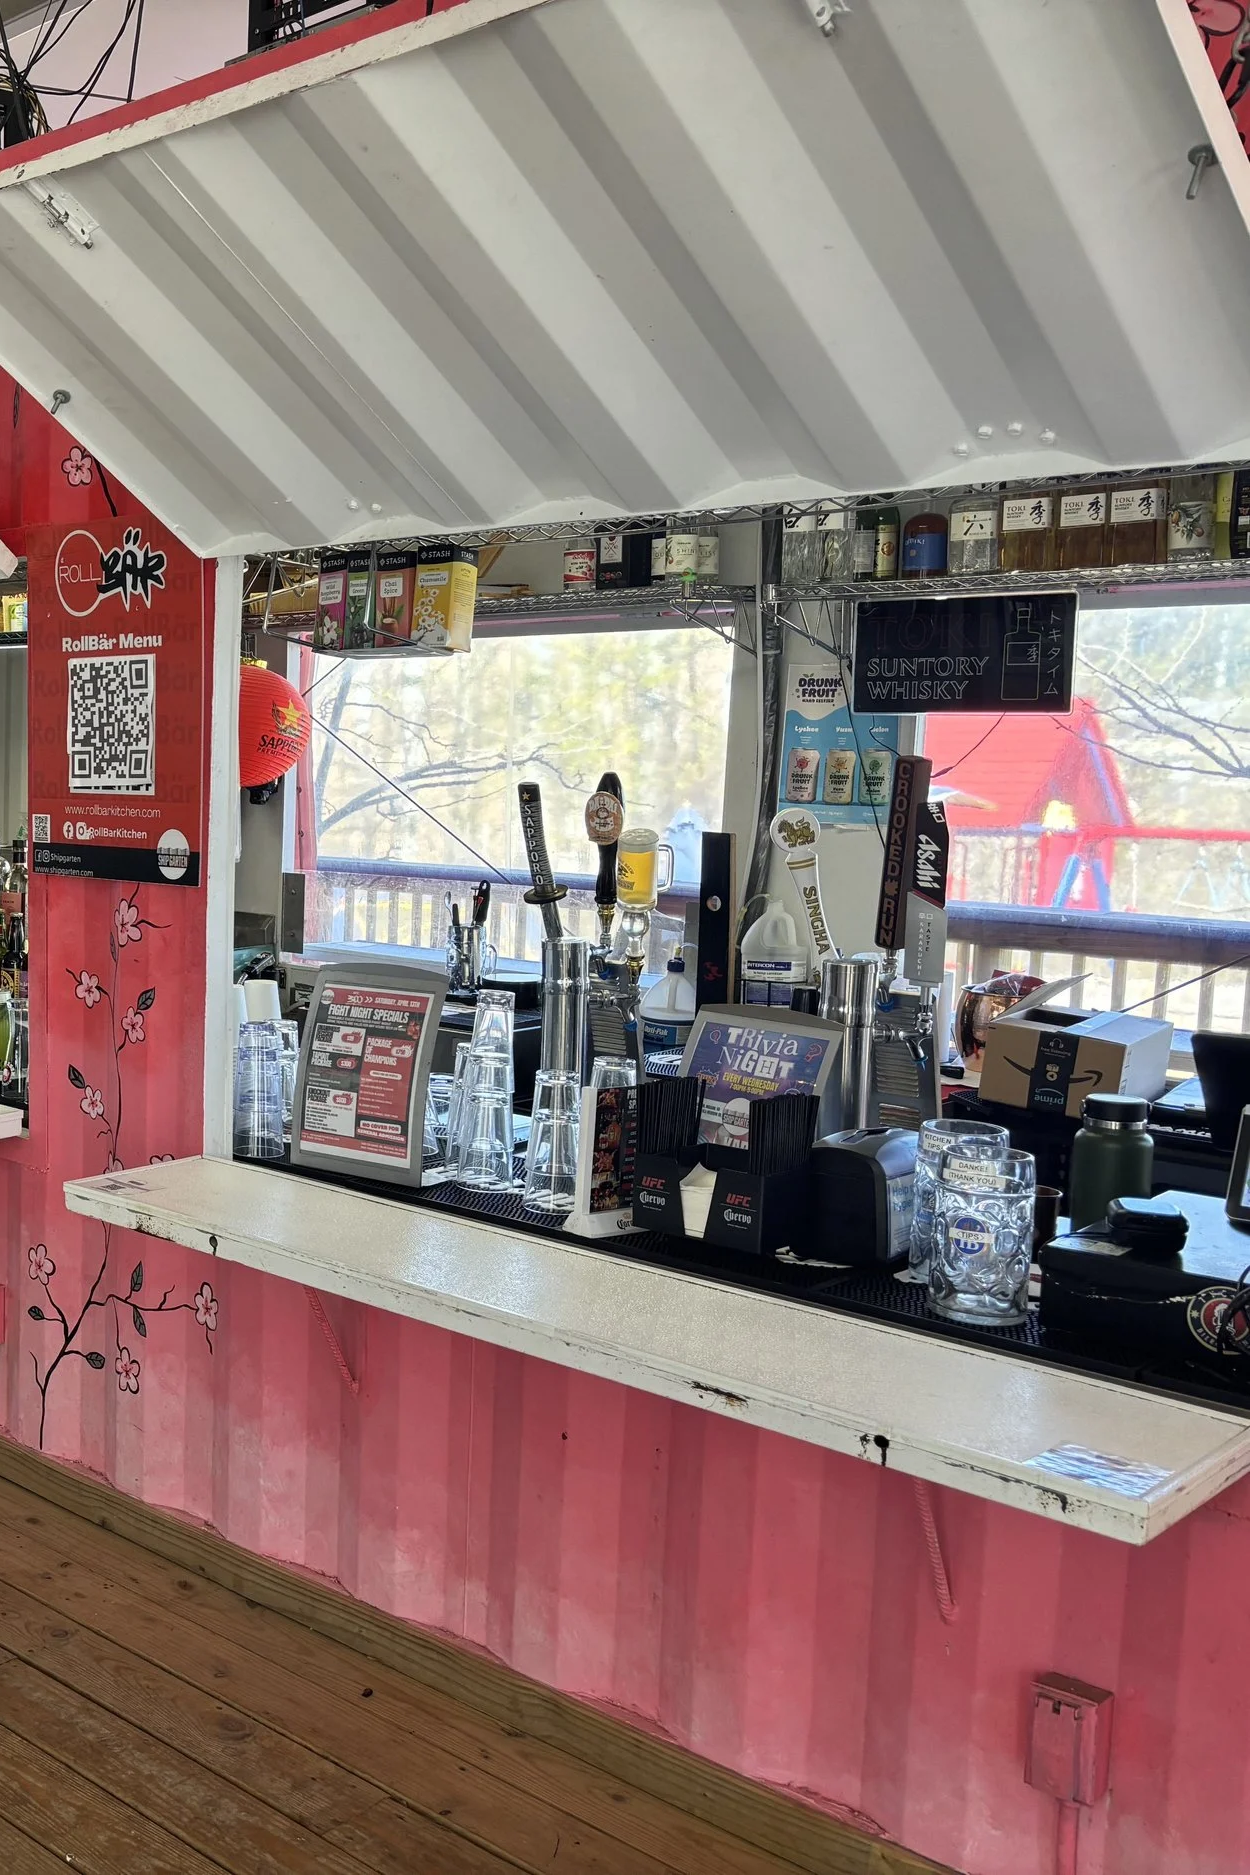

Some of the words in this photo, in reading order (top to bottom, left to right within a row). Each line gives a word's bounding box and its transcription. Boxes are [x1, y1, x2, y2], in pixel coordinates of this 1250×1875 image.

[385, 556, 407, 565] STASH
[427, 550, 451, 558] STASH
[327, 558, 346, 567] STASH
[59, 563, 101, 584] ROLL
[383, 587, 398, 595] Spice
[62, 634, 117, 652] RollBär
[119, 633, 163, 648] Menu
[867, 656, 990, 678] SUNTORY
[798, 677, 843, 688] DRUNK
[801, 688, 838, 698] FRUIT
[867, 680, 970, 700] WHISKY
[794, 725, 819, 733] Lychee
[65, 804, 161, 818] www.rollbarkitchen.com
[886, 764, 912, 877] CROOKED
[524, 804, 544, 886] SAPPORO
[50, 853, 82, 864] Shipgarten
[916, 834, 941, 889] Asahi
[34, 865, 94, 877] www.shipgarten.com
[803, 885, 830, 956] SINGHA
[879, 899, 896, 946] RUN
[328, 1004, 350, 1016] FIGHT
[350, 1006, 373, 1019] NIGHT
[373, 1009, 410, 1024] SPECIALS
[367, 1037, 393, 1048] PACKAGE
[364, 1054, 398, 1066] CHAMPIONS
[722, 1072, 743, 1084] EVERY
[742, 1075, 780, 1091] WEDNESDAY
[723, 1114, 750, 1126] SHIPGARTE
[357, 1128, 378, 1137] GENERAL
[924, 1133, 952, 1144] KITCHEN
[958, 1161, 988, 1172] DANKE!
[642, 1176, 666, 1190] UFC
[639, 1191, 666, 1206] Cuervo
[726, 1193, 752, 1207] UFC
[723, 1208, 752, 1225] Cuervo
